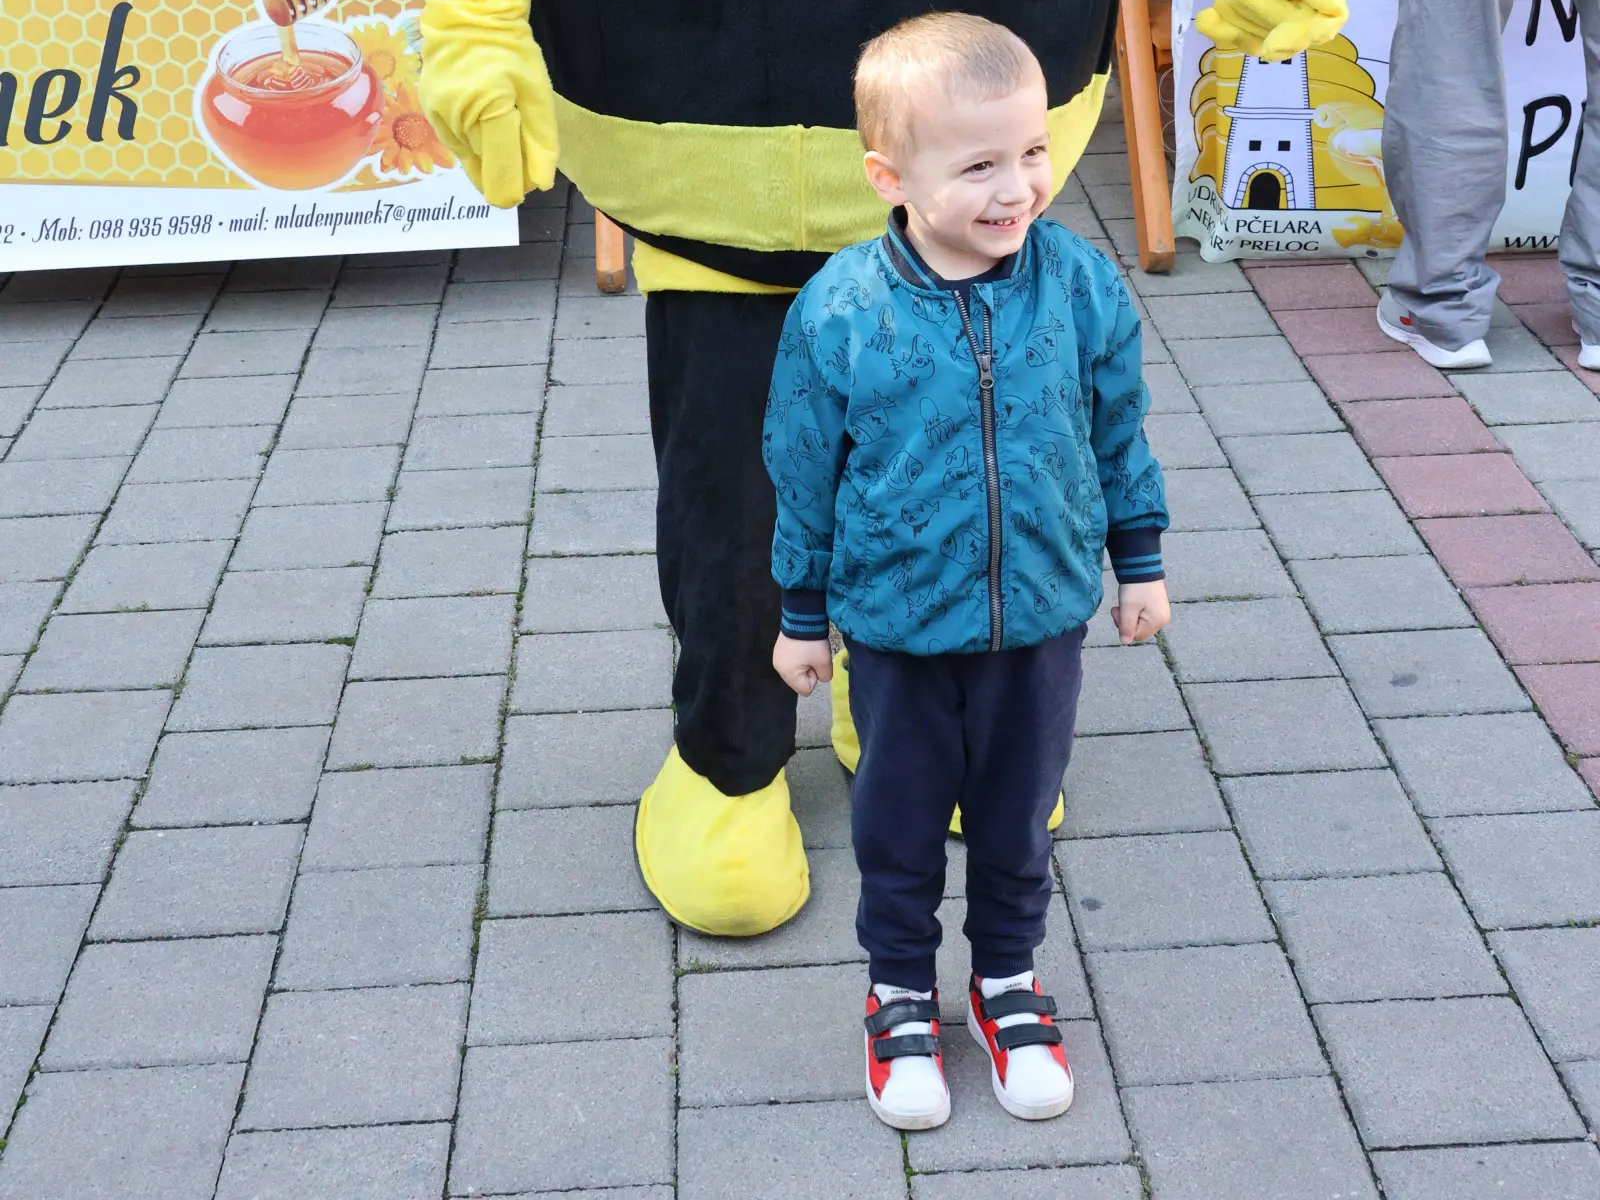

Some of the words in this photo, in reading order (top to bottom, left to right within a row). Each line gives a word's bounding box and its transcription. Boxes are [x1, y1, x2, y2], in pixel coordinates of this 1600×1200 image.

[1515, 94, 1587, 190] P
[0, 224, 14, 244] 2
[32, 217, 83, 243] Mob:
[89, 219, 124, 240] 098
[128, 217, 163, 238] 935
[168, 214, 213, 236] 9598
[229, 207, 269, 232] mail:
[274, 196, 491, 236] mladenpunek7@gmail.com
[1235, 215, 1322, 234] PČELARA
[1240, 240, 1319, 252] PRELOG
